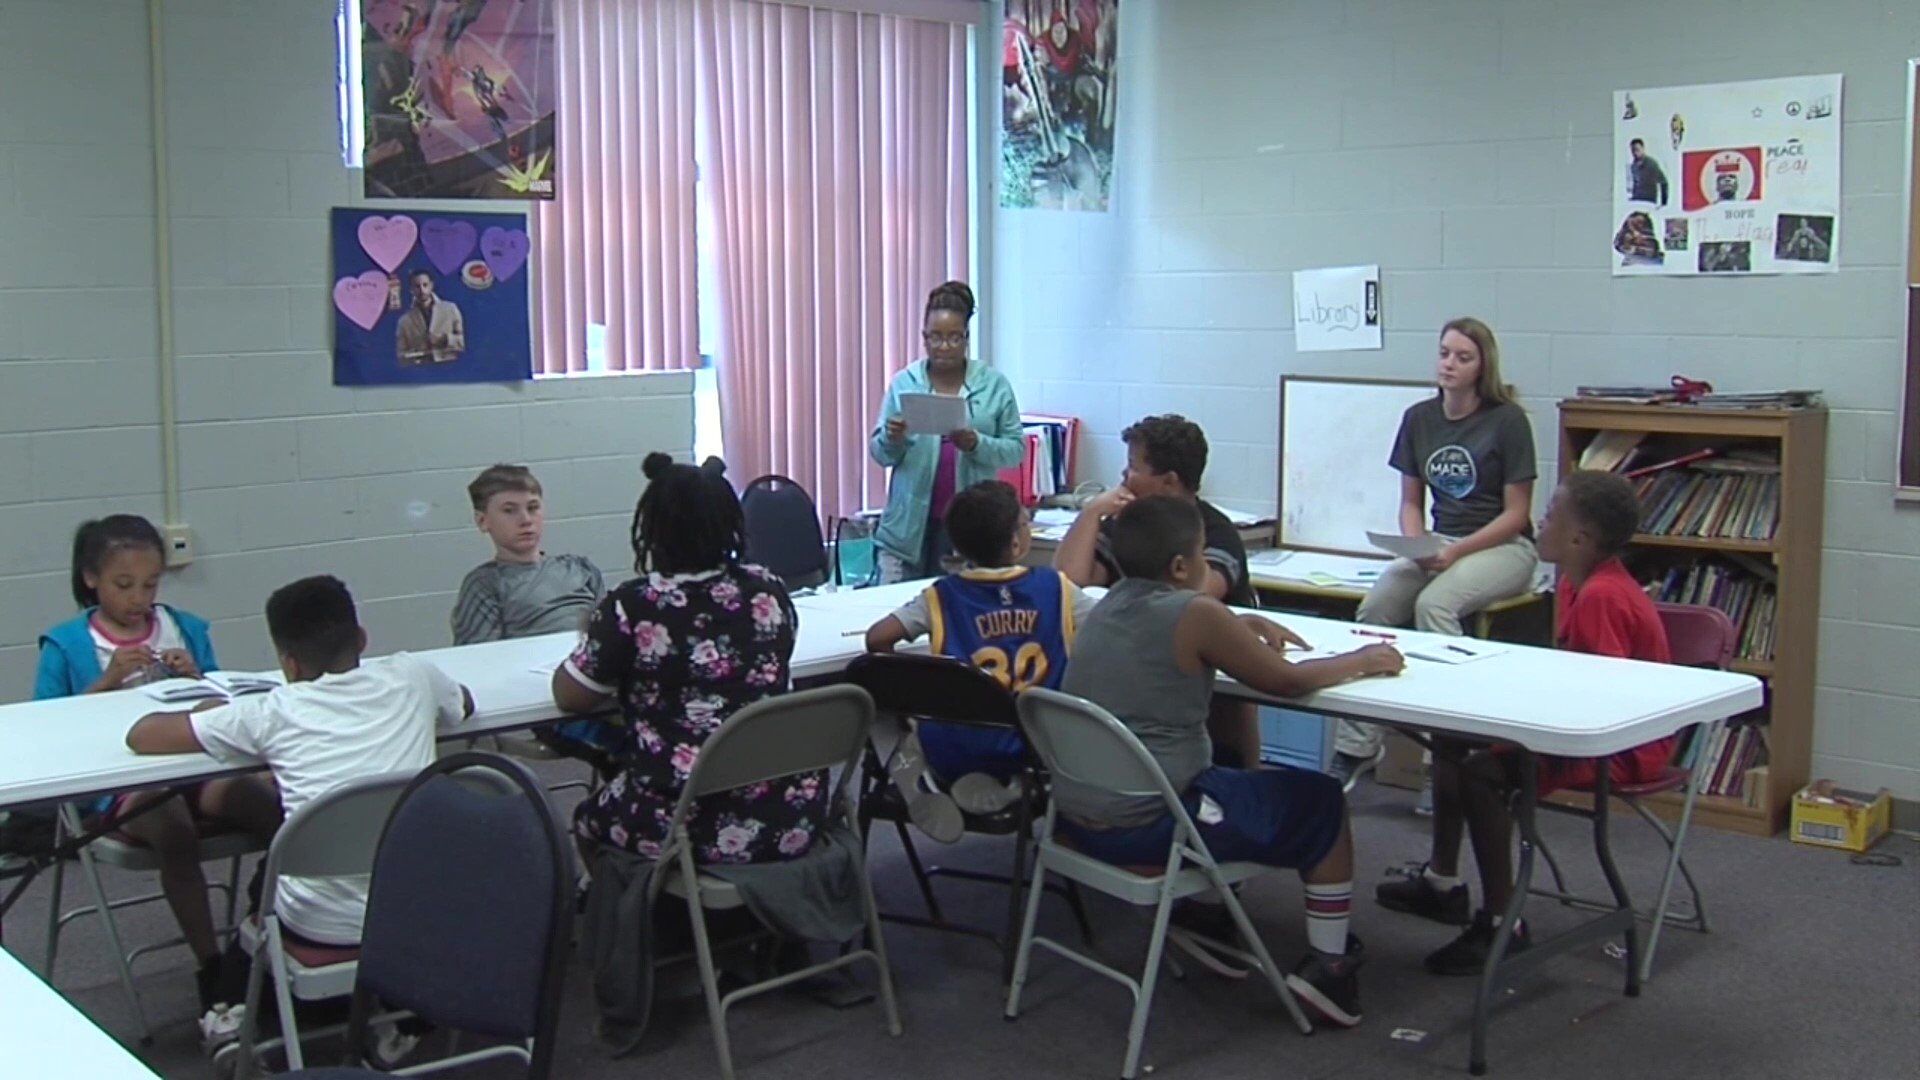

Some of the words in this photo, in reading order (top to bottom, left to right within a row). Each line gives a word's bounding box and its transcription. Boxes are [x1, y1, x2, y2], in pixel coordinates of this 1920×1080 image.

[1766, 144, 1804, 158] PEACE
[1724, 208, 1756, 220] HOPE
[1297, 291, 1360, 332] Library
[1430, 462, 1470, 477] MADE
[974, 608, 1038, 639] CURRY
